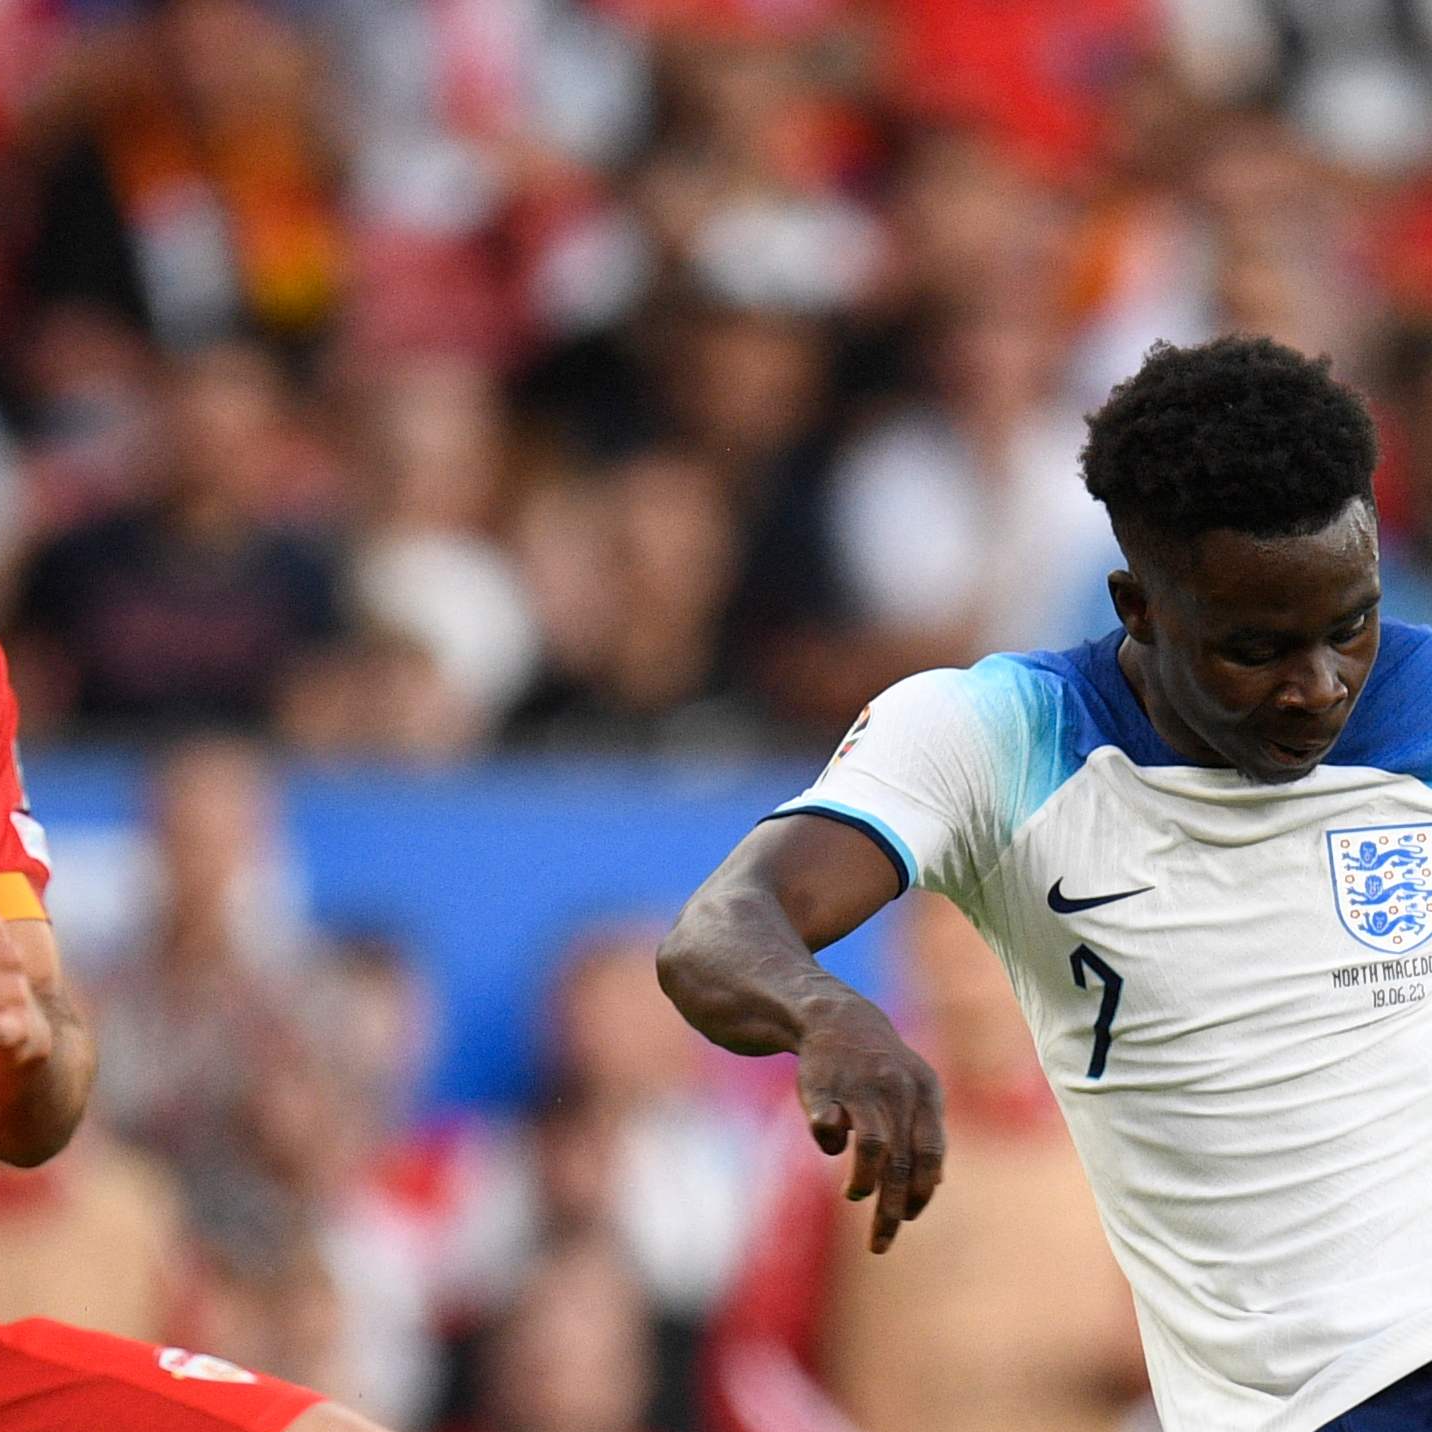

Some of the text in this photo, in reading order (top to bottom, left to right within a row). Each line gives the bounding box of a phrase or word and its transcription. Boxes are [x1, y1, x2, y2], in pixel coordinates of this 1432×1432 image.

[1332, 962, 1379, 988] NORTH
[1371, 983, 1426, 1008] 19.06.23
[1069, 943, 1124, 1080] 7
